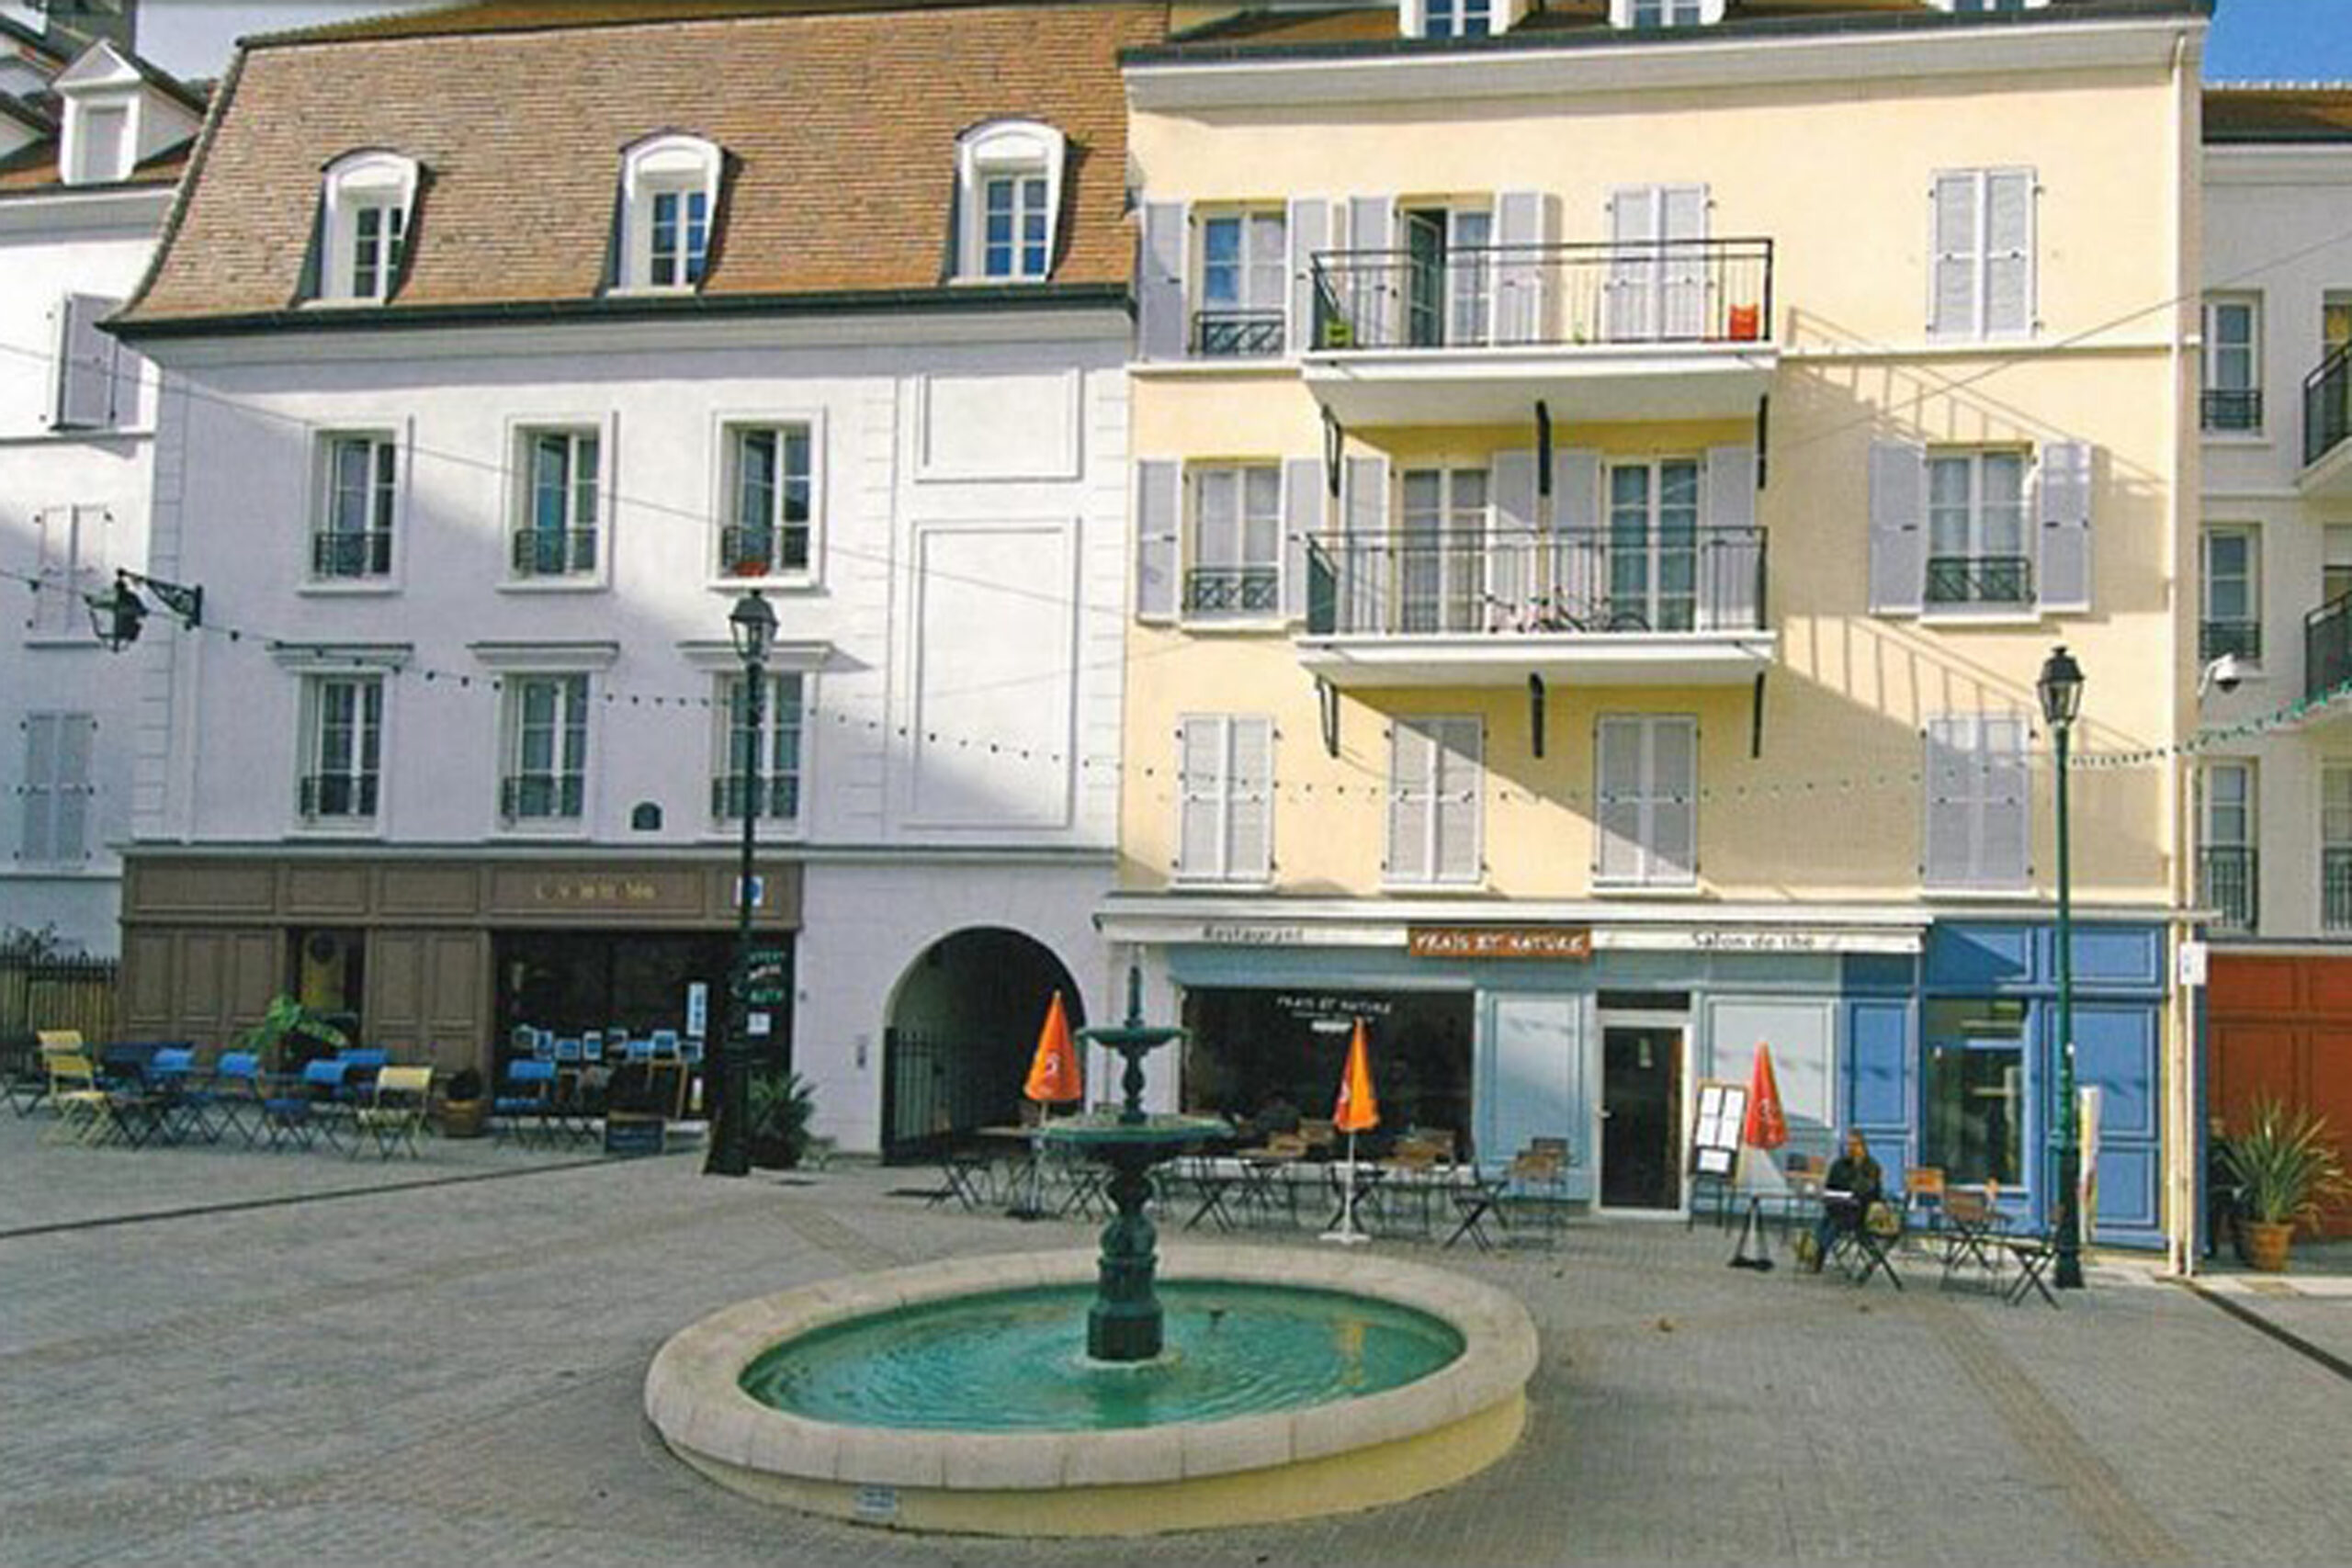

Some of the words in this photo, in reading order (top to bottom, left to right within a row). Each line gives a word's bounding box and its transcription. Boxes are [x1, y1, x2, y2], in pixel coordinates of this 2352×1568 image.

[1203, 924, 1305, 944] Restaurant
[1416, 931, 1470, 950] FRAIS
[1476, 931, 1505, 950] ET
[1510, 931, 1584, 950] NATURE
[1692, 931, 1747, 947] Salon
[1750, 931, 1776, 946] de
